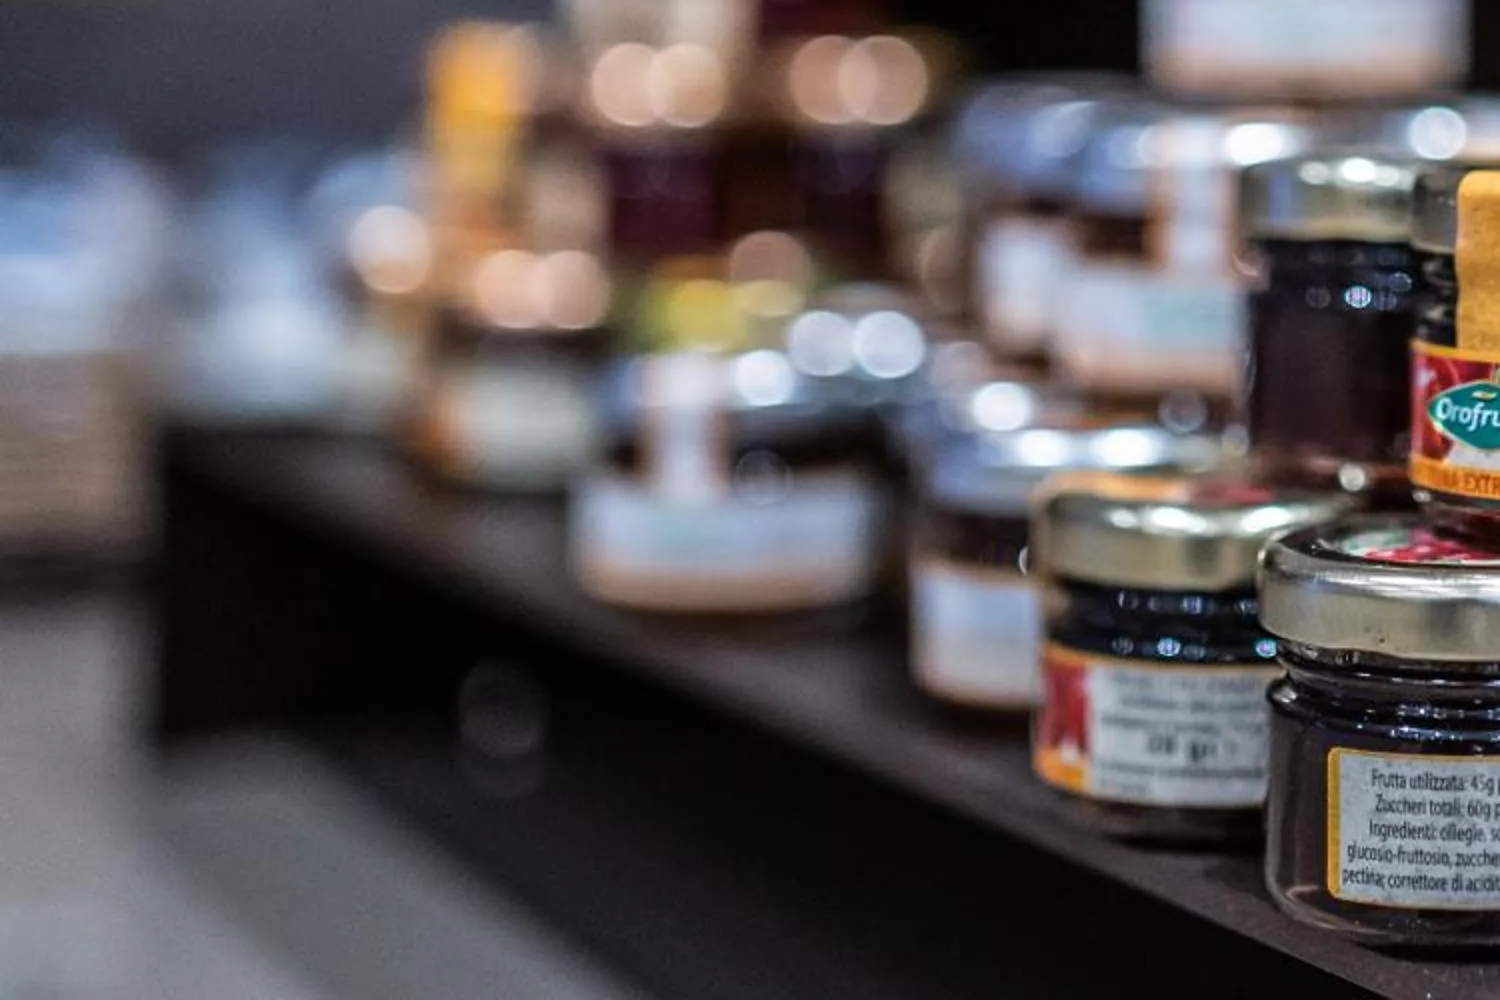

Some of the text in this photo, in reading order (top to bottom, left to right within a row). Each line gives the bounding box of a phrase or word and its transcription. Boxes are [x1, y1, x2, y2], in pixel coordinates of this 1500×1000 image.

[1370, 767, 1407, 789] Frutta
[1409, 771, 1466, 792] utilizzata:
[1375, 793, 1427, 815] Zuccheri
[1467, 799, 1492, 822] 60g
[1369, 819, 1437, 843] Ingredienti:
[1387, 873, 1449, 892] correttore
[1451, 872, 1464, 892] di
